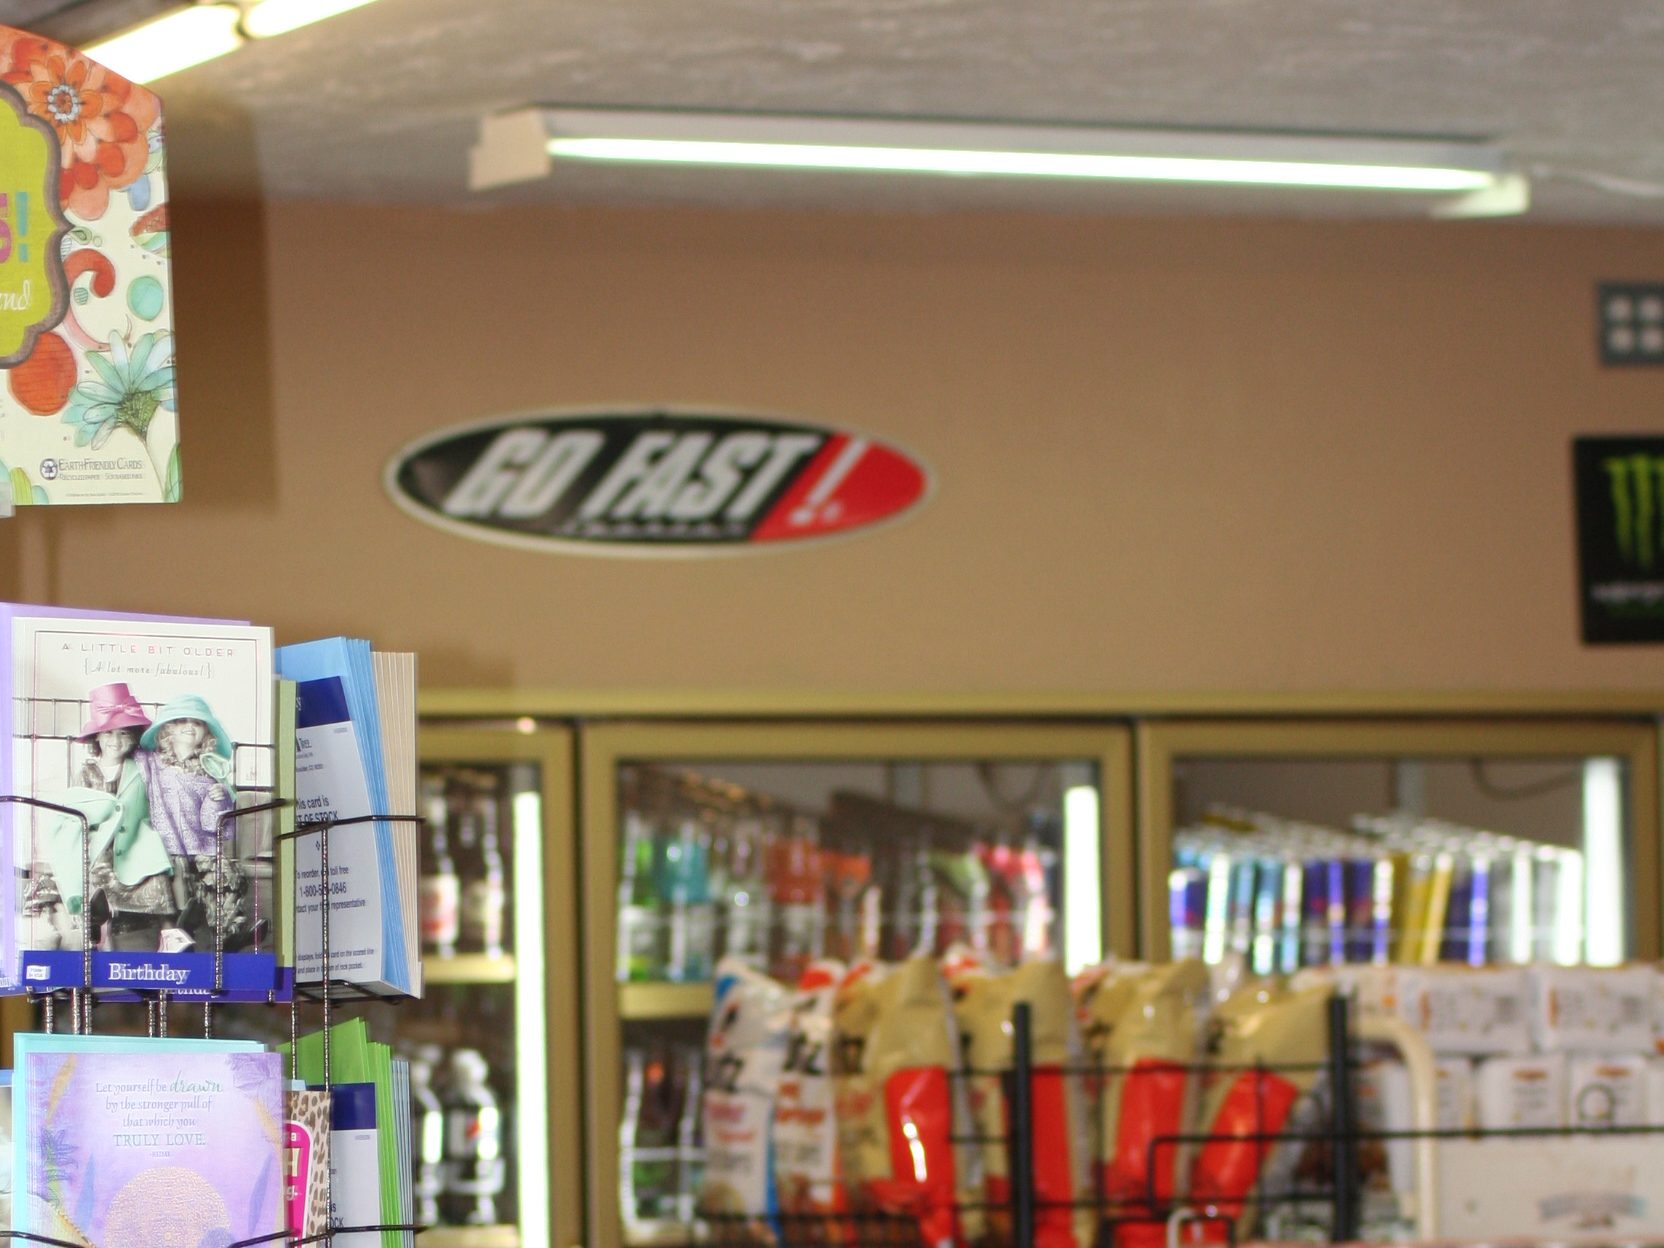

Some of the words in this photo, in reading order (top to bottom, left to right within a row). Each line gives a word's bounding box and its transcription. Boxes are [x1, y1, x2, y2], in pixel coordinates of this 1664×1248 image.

[443, 428, 606, 519] GO
[61, 643, 70, 651] A
[81, 643, 137, 653] LITTLE
[148, 645, 174, 655] BIT
[183, 647, 234, 657] OLDER
[307, 794, 322, 809] card
[322, 796, 330, 807] is
[300, 882, 347, 898] 1-800-5-0846
[108, 963, 191, 985] Birthday
[96, 1082, 112, 1093] Let
[114, 1079, 155, 1095] yourself
[156, 1079, 167, 1092] be
[169, 1070, 224, 1093] drawn
[105, 1096, 118, 1113] by
[120, 1096, 136, 1110] the
[138, 1099, 178, 1113] stronger
[180, 1095, 201, 1112] pull
[202, 1095, 213, 1112] of
[123, 1114, 143, 1127] that
[145, 1113, 174, 1127] which
[176, 1118, 196, 1130] you
[113, 1133, 160, 1147] TRULY
